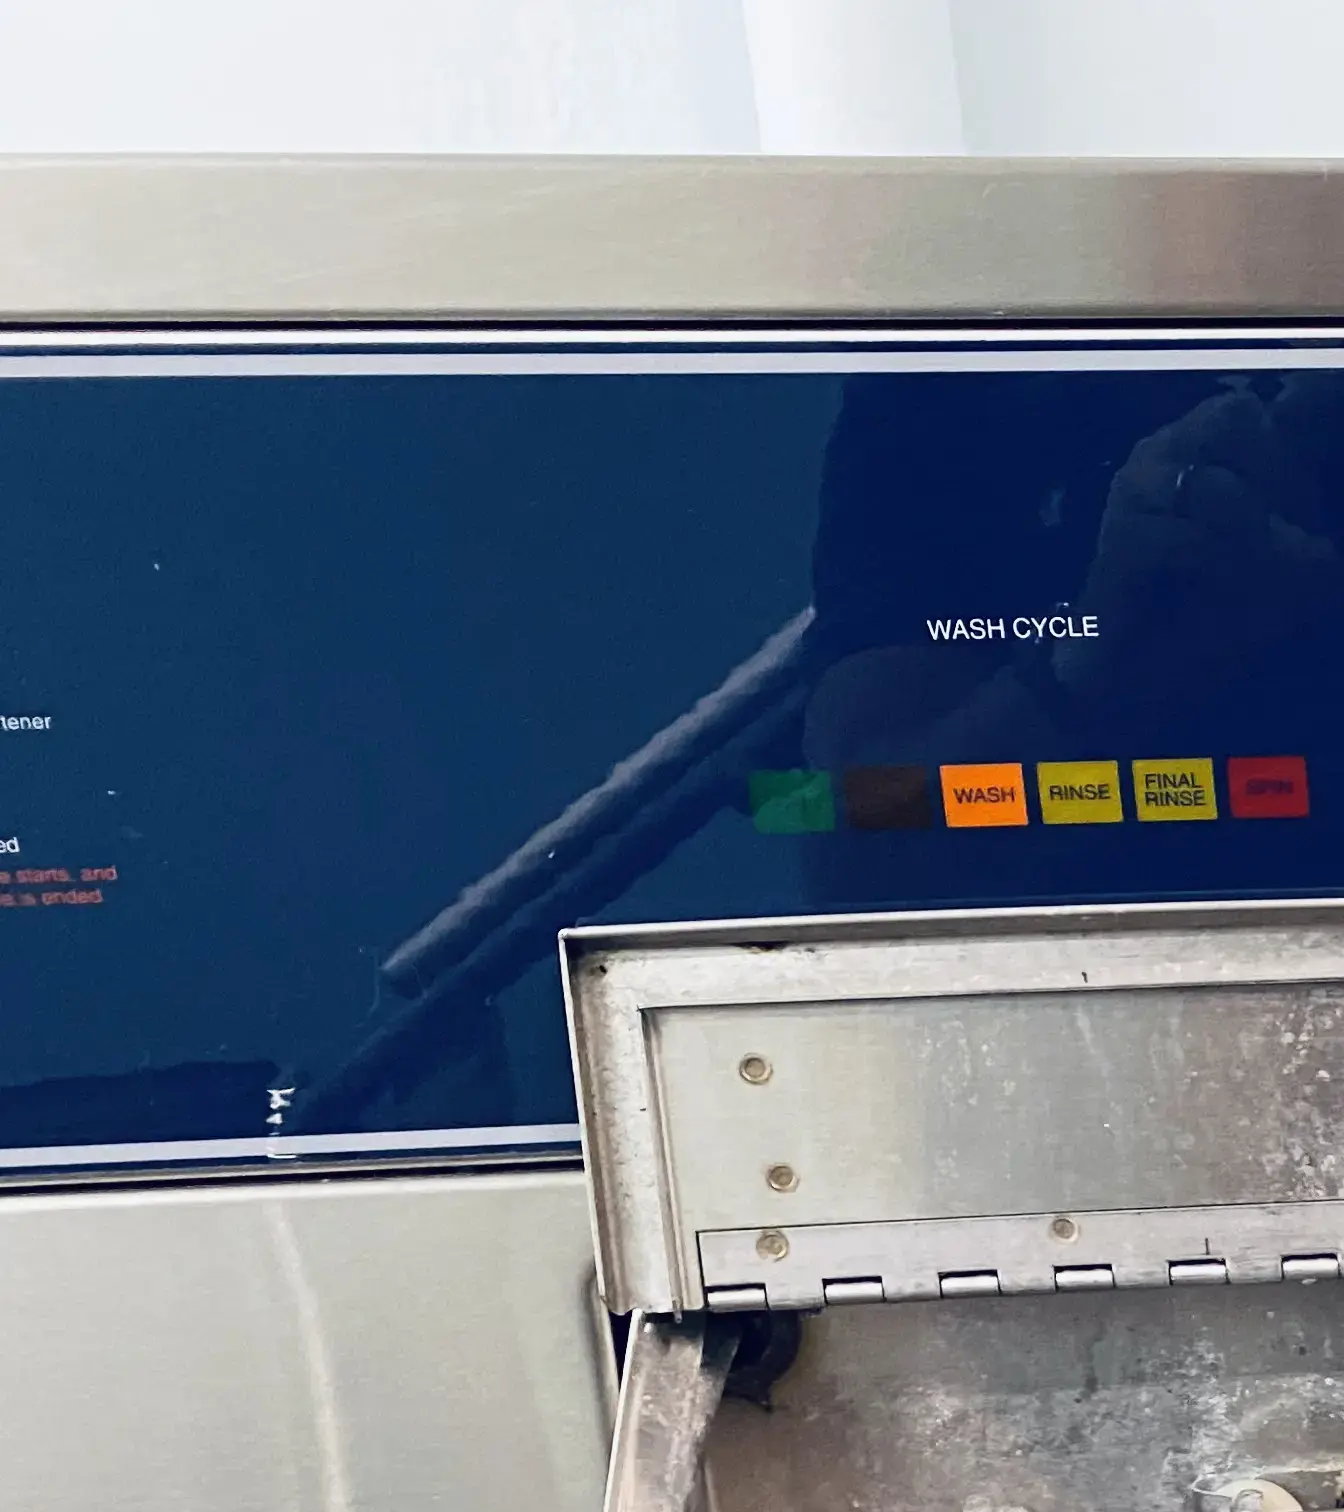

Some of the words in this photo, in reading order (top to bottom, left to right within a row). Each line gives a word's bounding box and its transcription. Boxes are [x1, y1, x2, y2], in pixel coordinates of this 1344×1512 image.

[926, 618, 1005, 641] WASH
[1012, 616, 1100, 639] CYCLE
[1145, 773, 1202, 789] FINAL
[953, 787, 1017, 804] WASH
[1049, 784, 1111, 801] RINSE
[1145, 791, 1206, 807] RINSE
